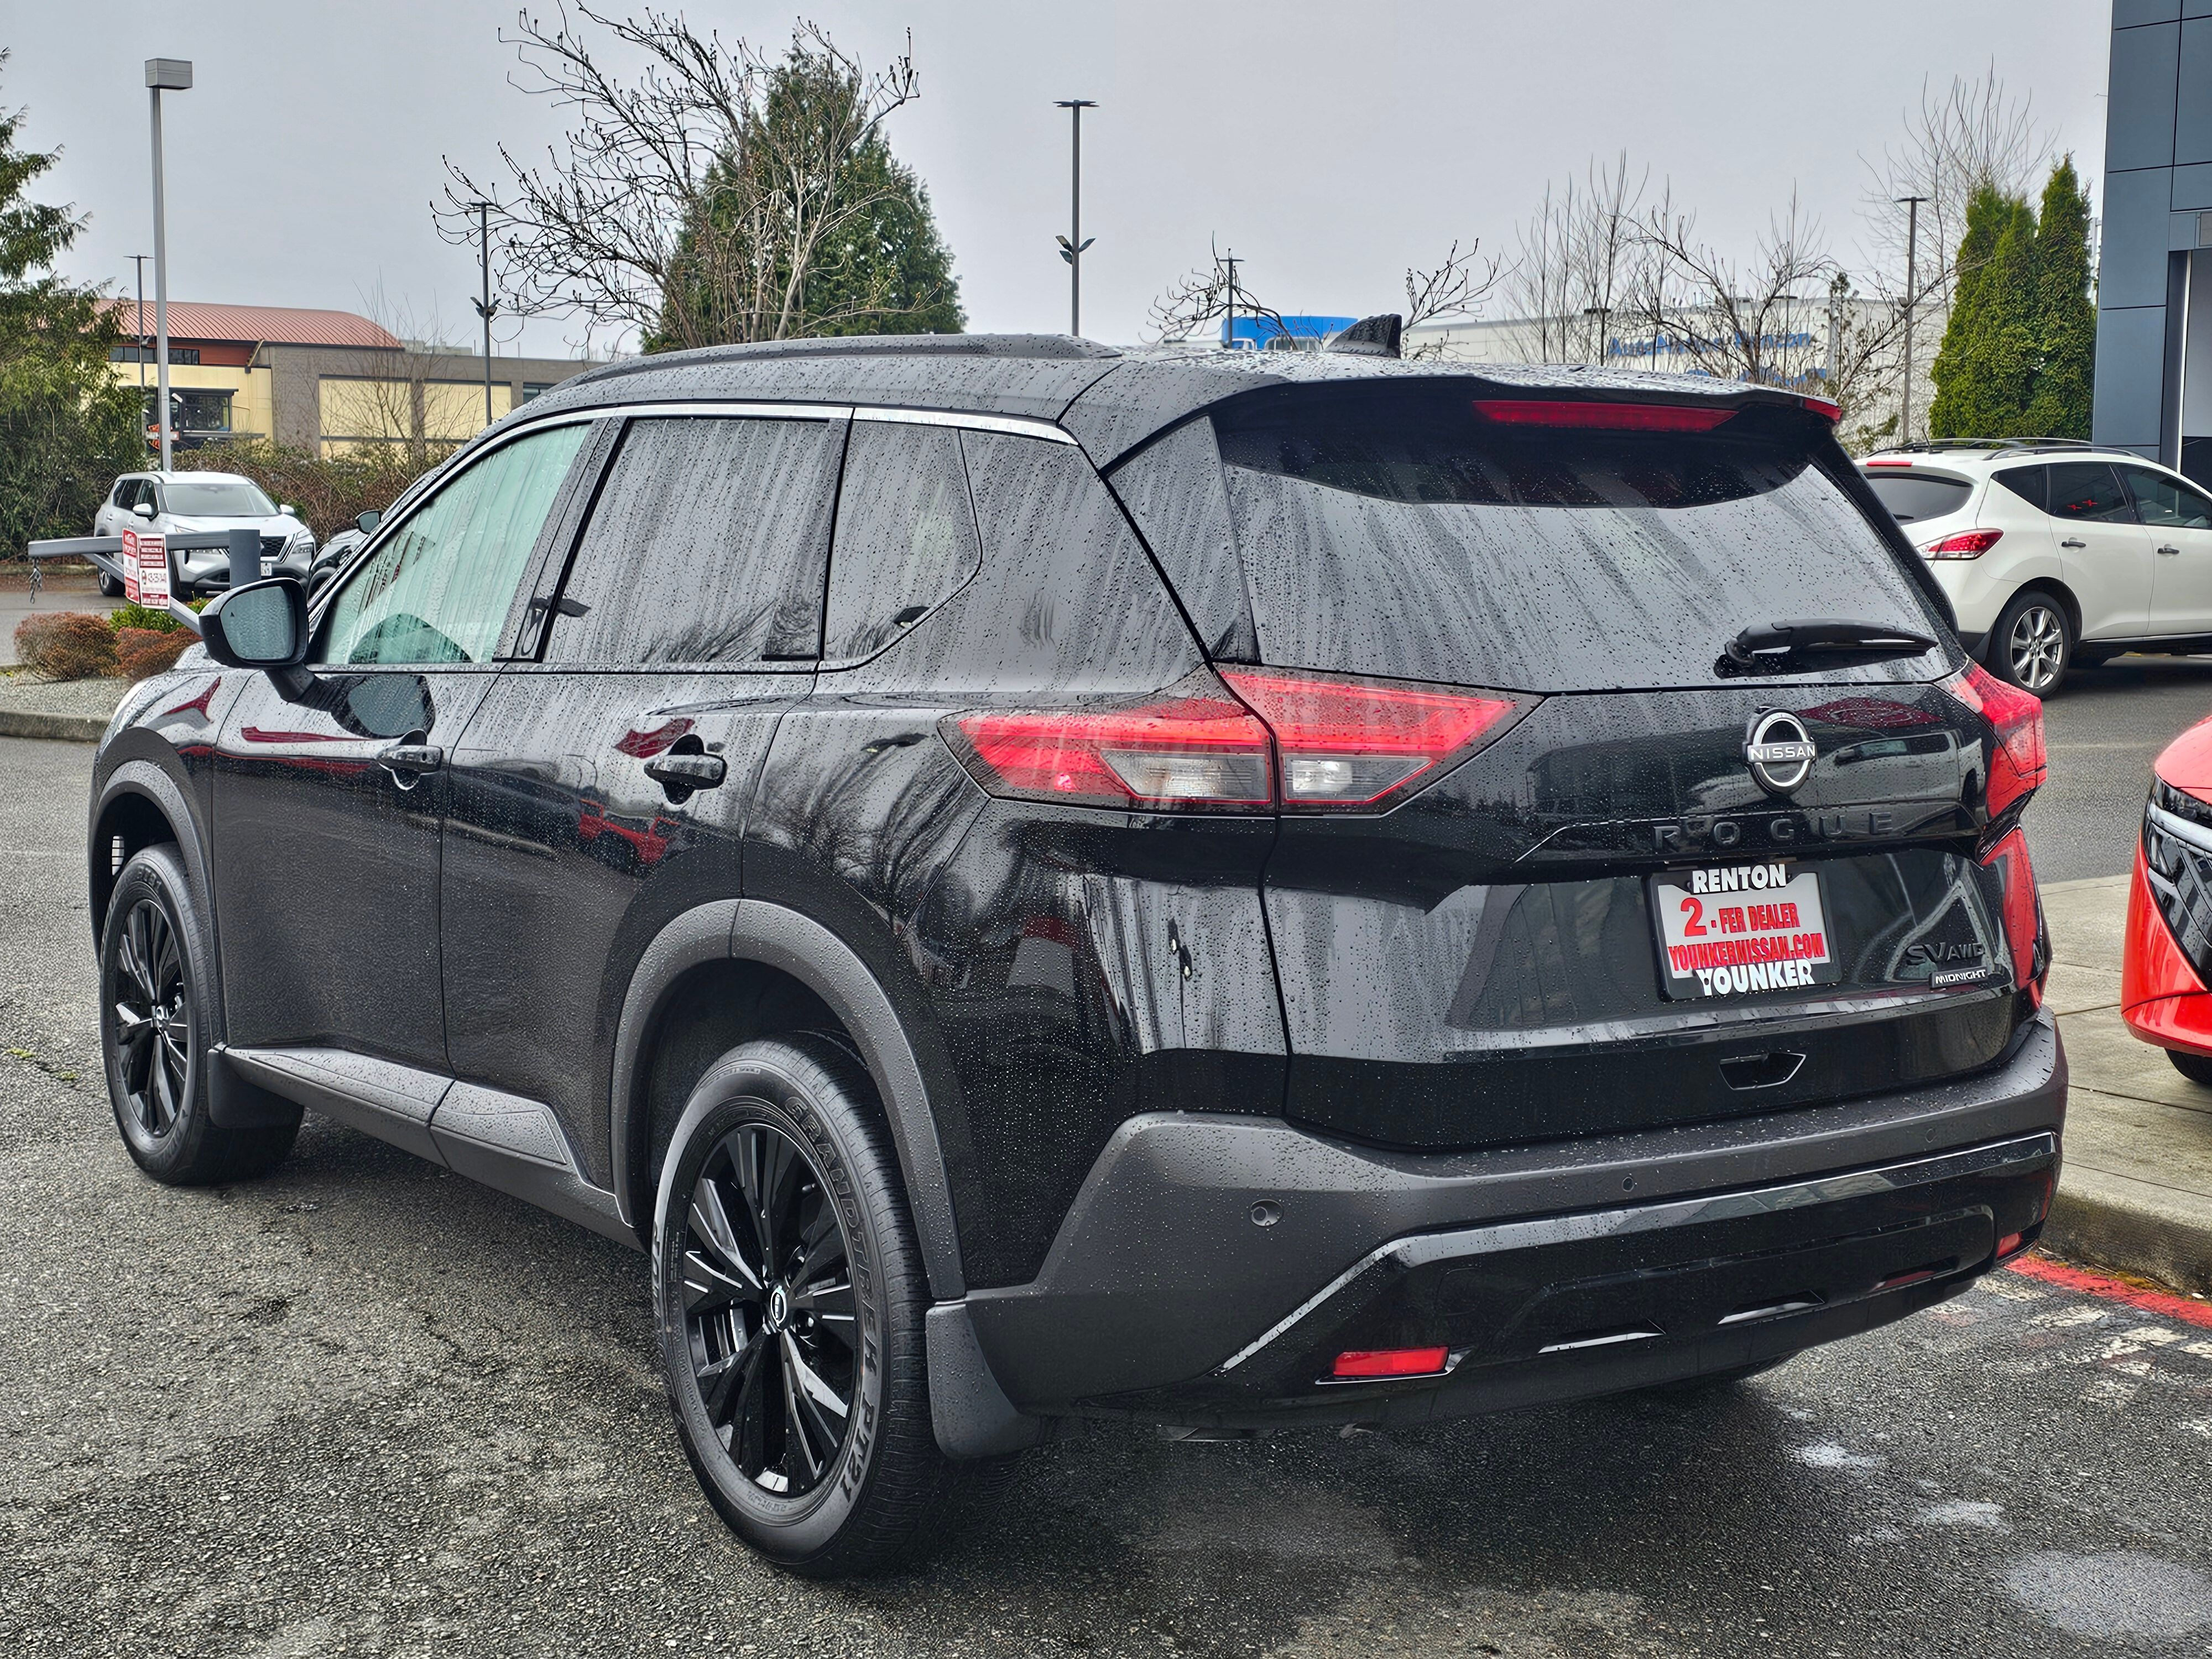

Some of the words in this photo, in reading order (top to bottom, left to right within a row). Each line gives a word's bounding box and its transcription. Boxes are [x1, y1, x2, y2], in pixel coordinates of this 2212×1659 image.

[1608, 334, 1725, 356] AutoN
[1734, 331, 1811, 349] Rnon
[1750, 745, 1815, 760] NISSAN
[1653, 811, 1893, 852] ROGUE
[1692, 864, 1787, 894] RENTON
[1747, 902, 1801, 932] DEALER
[1668, 932, 1826, 971] YOUNKERNISSAN.COM
[1906, 942, 1947, 965] SV
[1695, 959, 1815, 996] YOUNKER
[1935, 969, 1986, 984] MIDNIGHT
[784, 1096, 878, 1377] GRANDTREK
[839, 1391, 876, 1503] PT21
